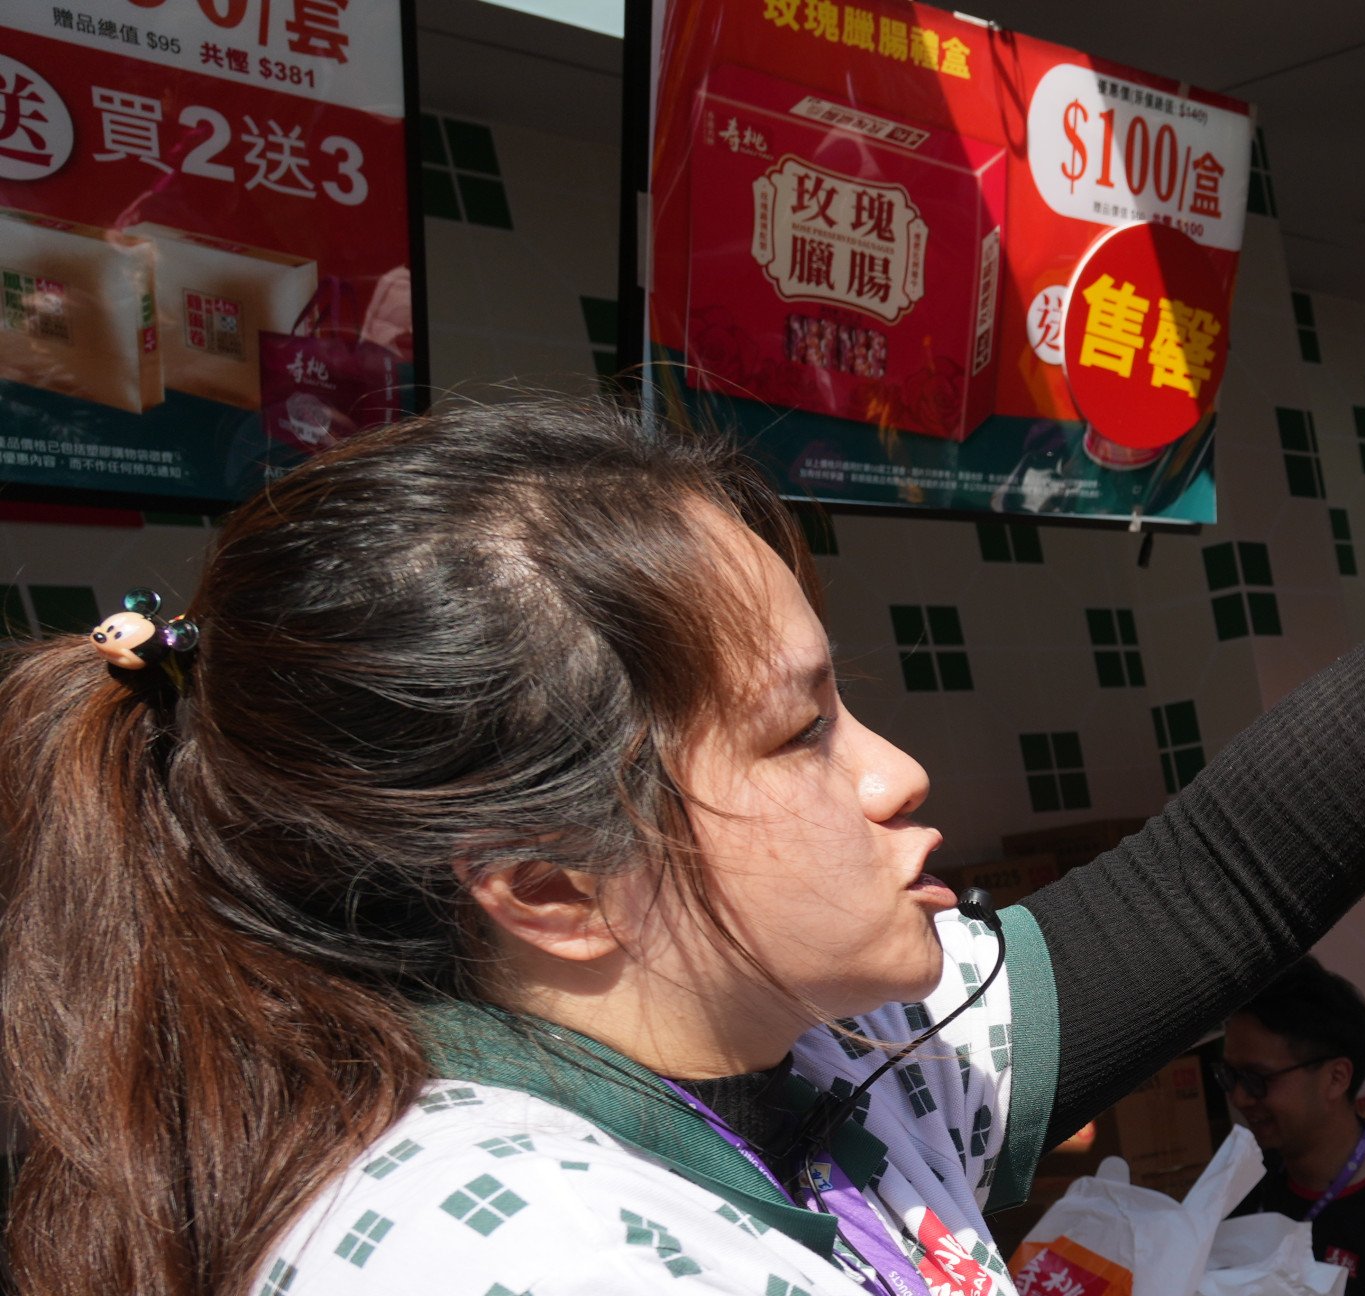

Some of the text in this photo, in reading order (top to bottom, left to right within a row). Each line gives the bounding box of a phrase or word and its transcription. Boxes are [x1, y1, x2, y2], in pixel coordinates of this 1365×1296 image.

[54, 7, 316, 88] 贈品總值 $95 共慳 $381
[91, 85, 369, 206] 買2送3
[1061, 98, 1225, 219] $100/盒
[791, 171, 896, 243] 玫瑰
[788, 234, 896, 304] 臘腸
[1079, 273, 1221, 397] 售罄
